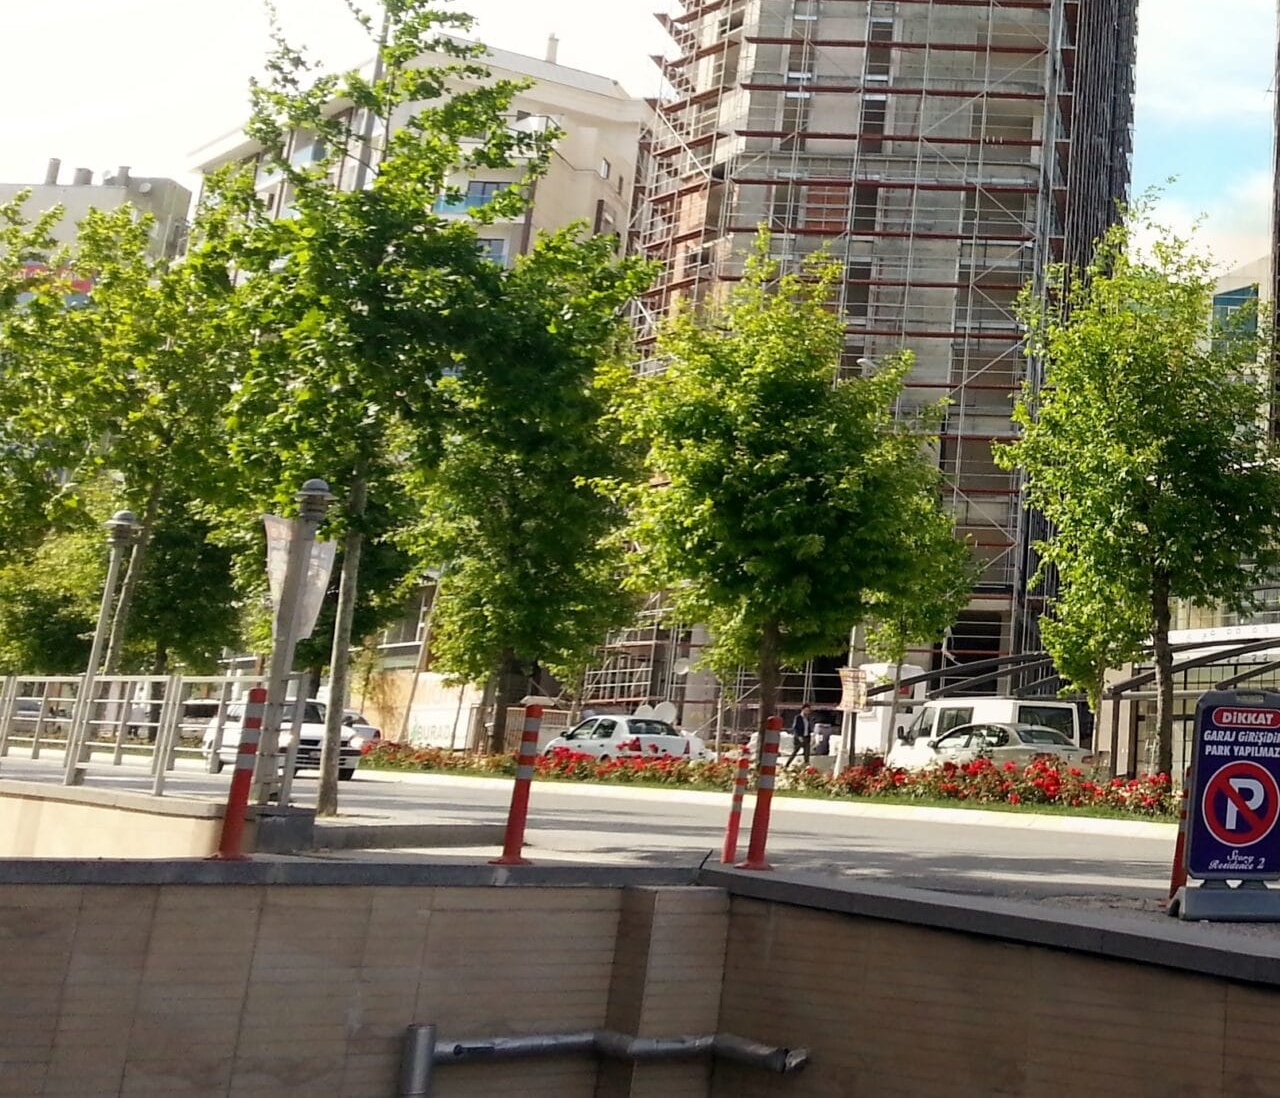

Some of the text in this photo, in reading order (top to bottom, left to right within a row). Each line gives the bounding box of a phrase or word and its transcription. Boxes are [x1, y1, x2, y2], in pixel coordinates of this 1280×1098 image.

[1222, 712, 1274, 725] DİKKAT
[1203, 730, 1236, 742] GARAJ
[1205, 744, 1231, 757] PARK
